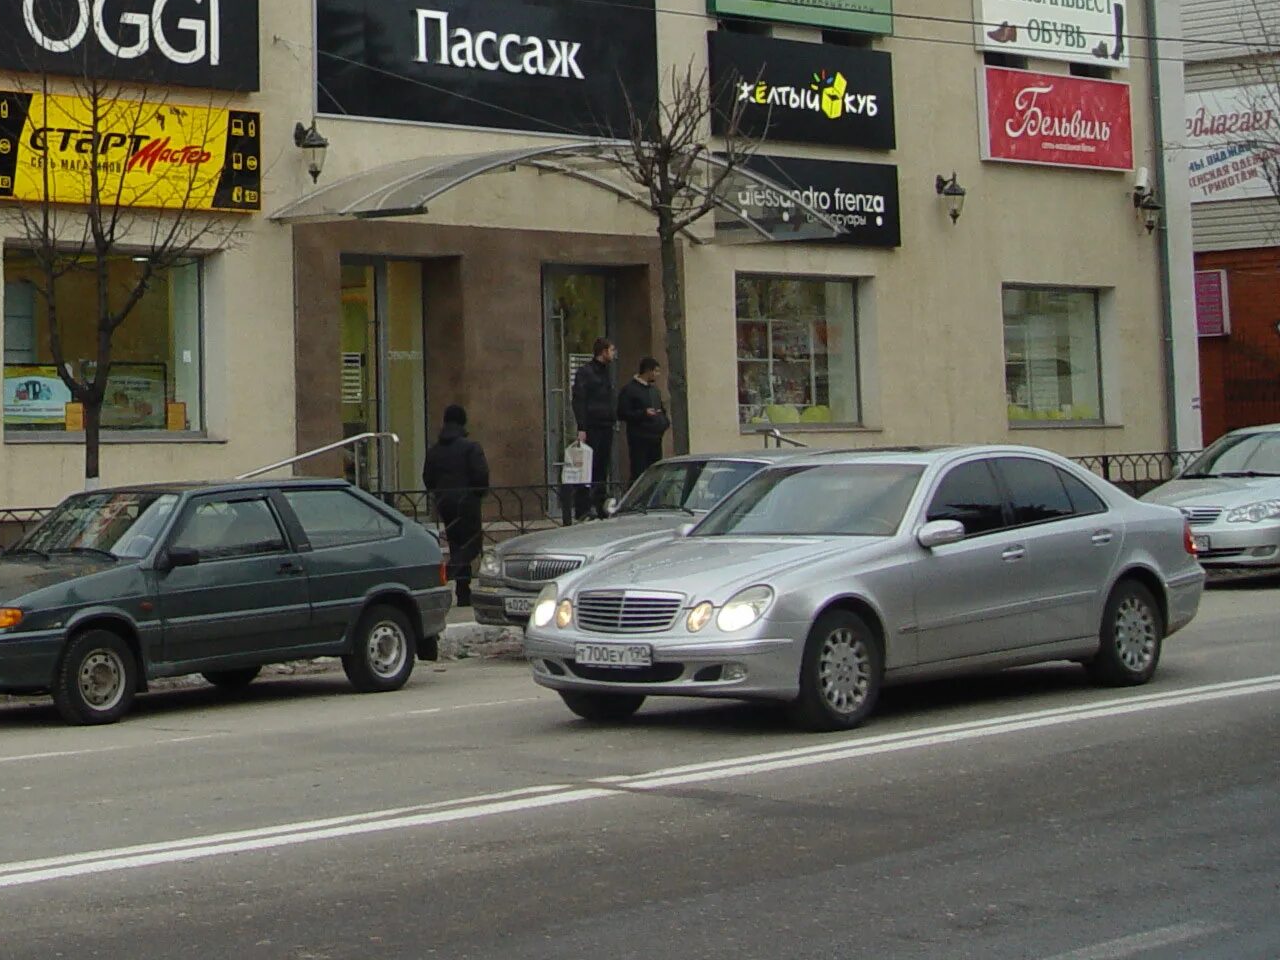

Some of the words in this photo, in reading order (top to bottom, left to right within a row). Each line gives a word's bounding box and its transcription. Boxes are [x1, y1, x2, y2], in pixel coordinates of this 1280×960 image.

[414, 8, 585, 80] Пассаж
[1027, 18, 1087, 49] ОБУВЬ
[1005, 84, 1111, 141] Бельвиль
[30, 157, 56, 169] СЕЬ
[60, 158, 121, 173] МАГАИНОВ
[833, 188, 885, 213] frenza
